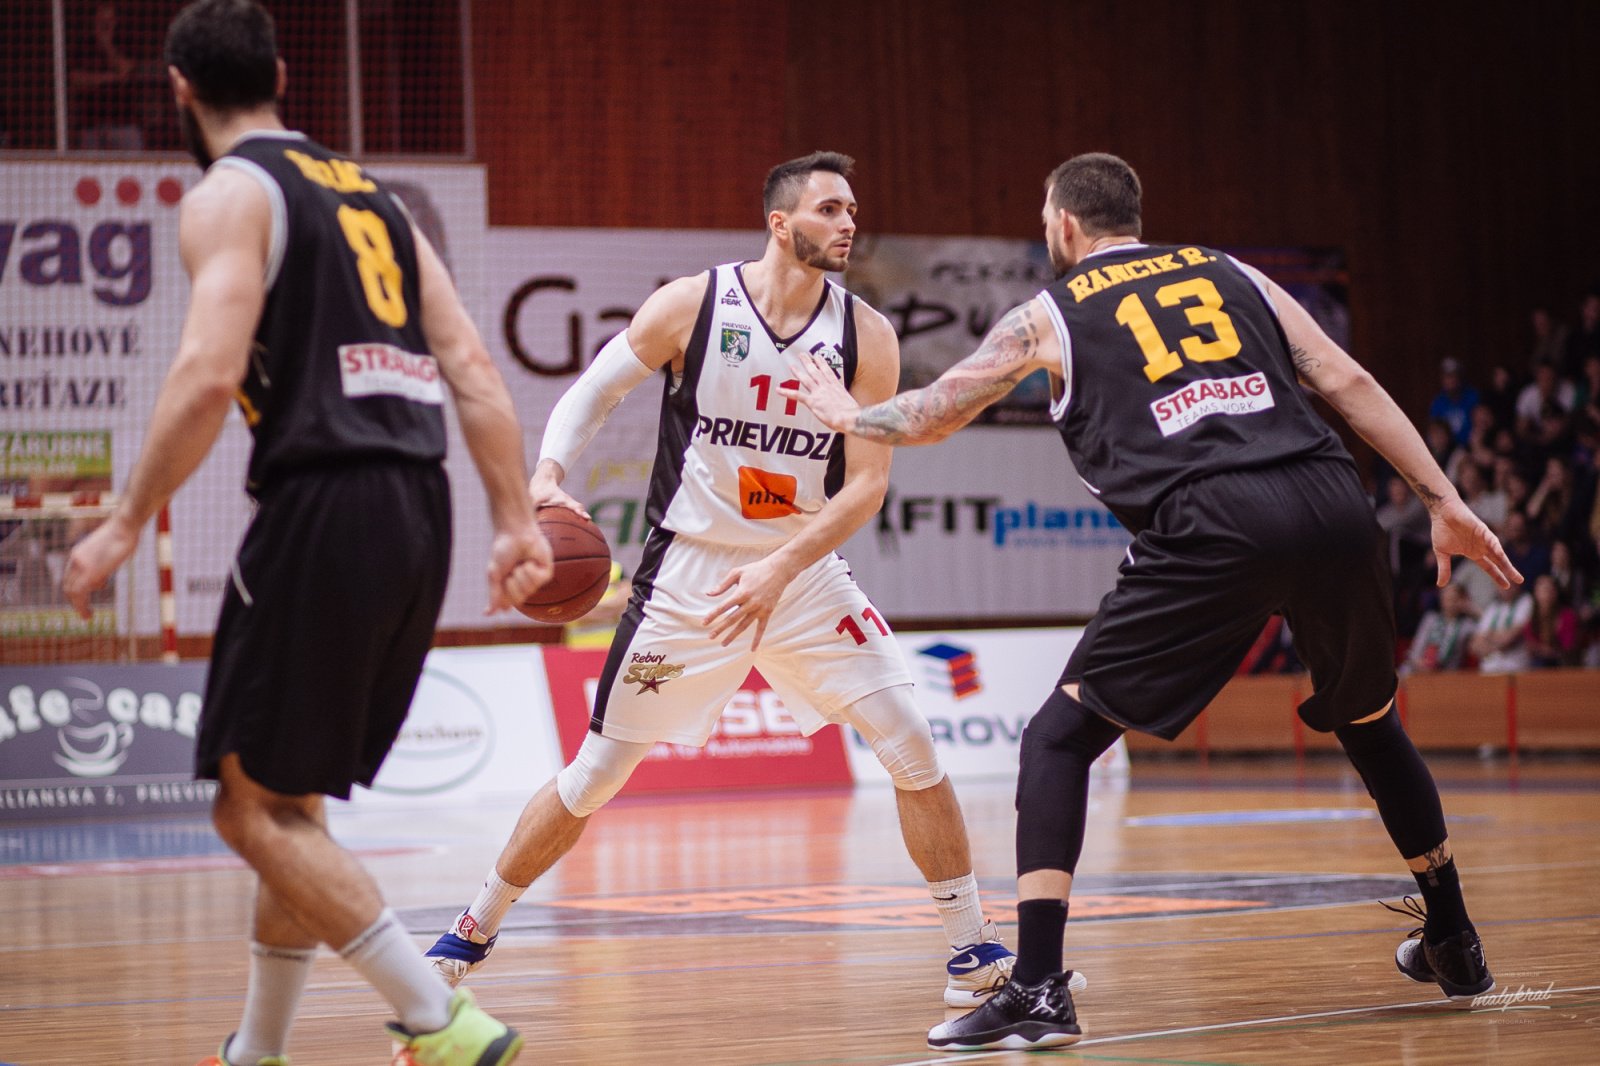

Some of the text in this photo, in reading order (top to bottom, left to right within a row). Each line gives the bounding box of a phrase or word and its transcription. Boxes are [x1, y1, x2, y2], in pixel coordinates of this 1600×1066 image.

[336, 203, 408, 328] 8
[1067, 253, 1183, 304] RANCIK
[1177, 247, 1217, 265] R.
[722, 321, 752, 331] PRIEVIDZA
[1115, 277, 1242, 383] 13
[750, 374, 800, 416] 11
[1155, 376, 1266, 421] STRABAG
[1177, 403, 1218, 427] TEAMS
[835, 607, 888, 646] 11
[623, 663, 686, 684] STARS
[631, 651, 666, 664] Rebuy
[107, 688, 202, 739] caf
[706, 690, 804, 737] SE
[0, 786, 96, 809] LIANSKA
